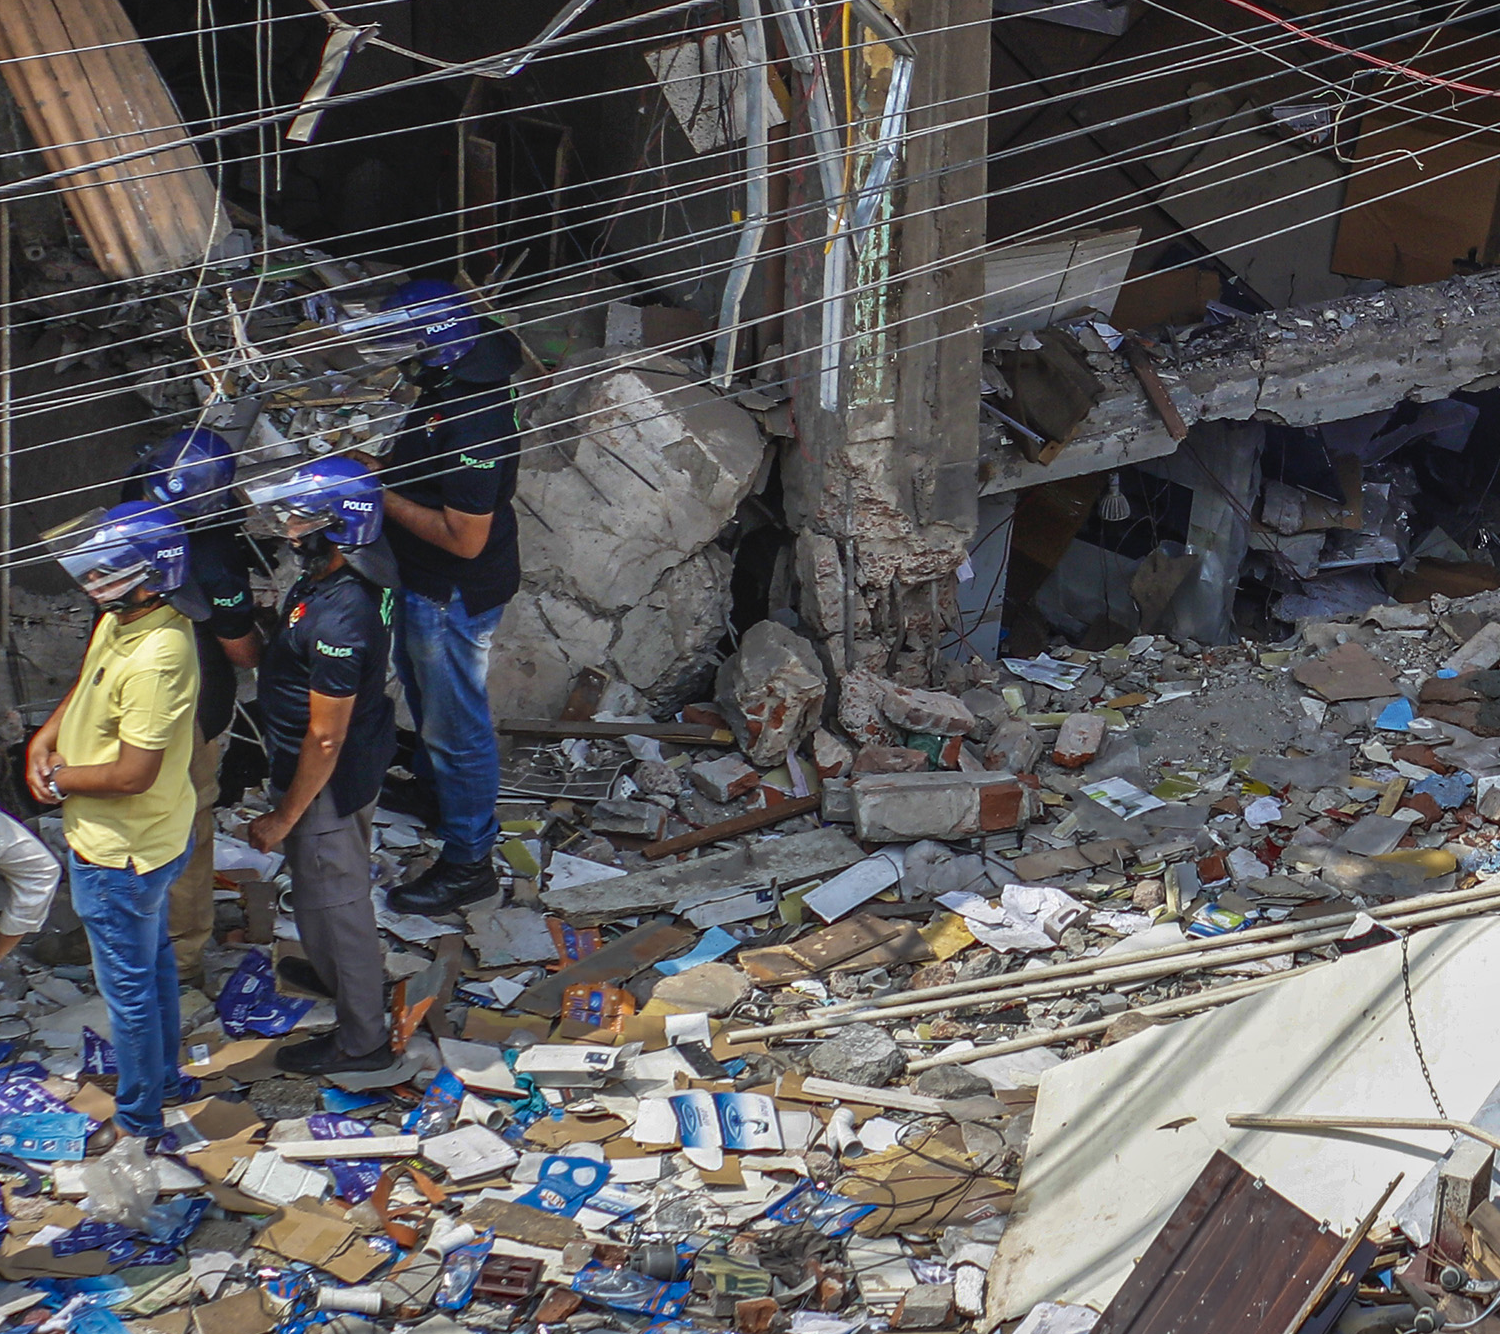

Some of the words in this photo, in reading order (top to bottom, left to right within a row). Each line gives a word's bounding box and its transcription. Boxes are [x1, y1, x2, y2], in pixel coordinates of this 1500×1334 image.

[426, 317, 458, 335] POLICE
[342, 499, 374, 513] POLICE
[156, 545, 185, 560] POLICE
[316, 640, 353, 657] POLICE
